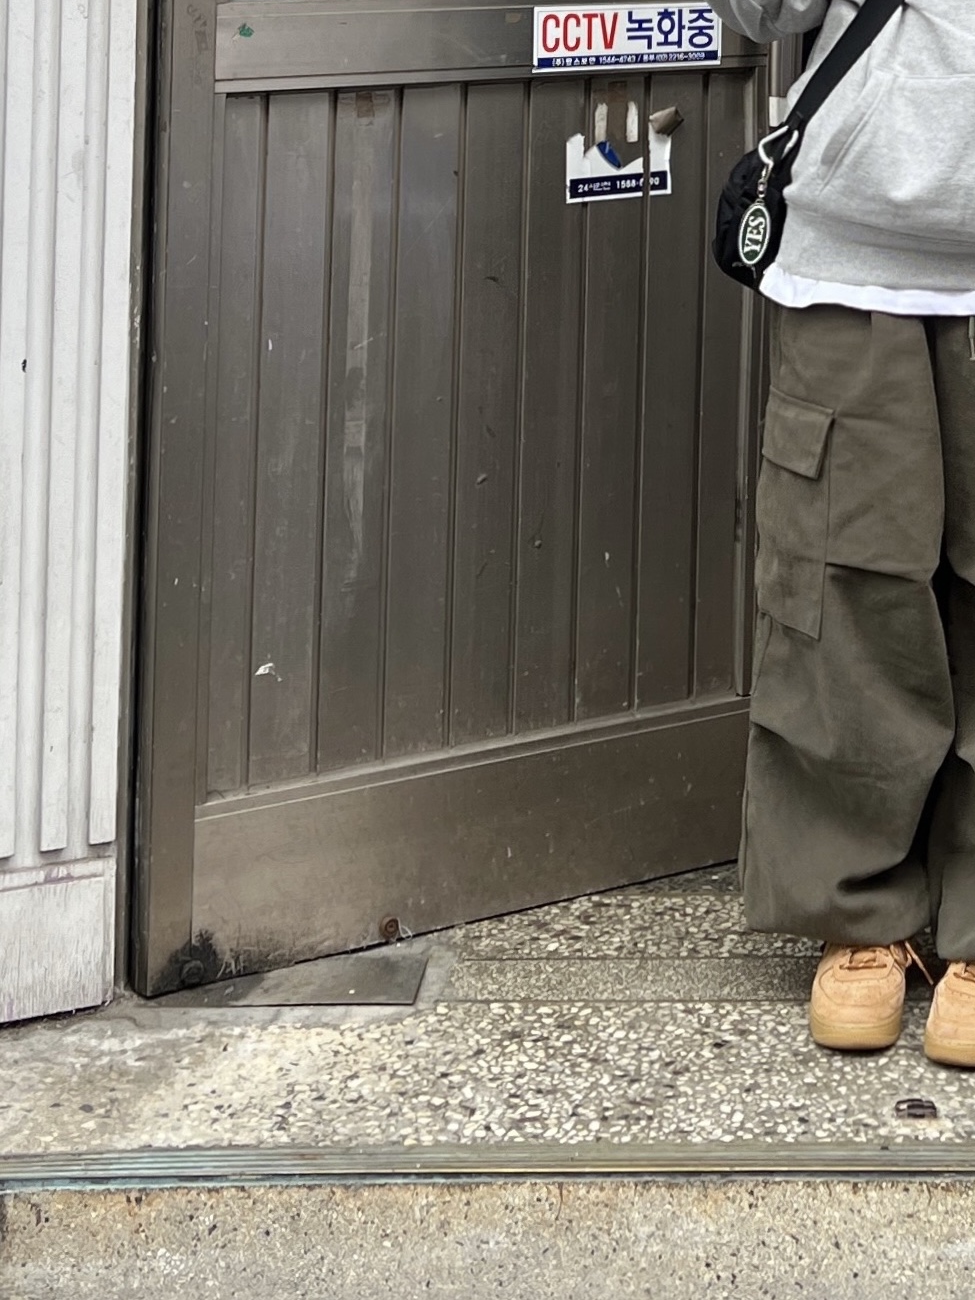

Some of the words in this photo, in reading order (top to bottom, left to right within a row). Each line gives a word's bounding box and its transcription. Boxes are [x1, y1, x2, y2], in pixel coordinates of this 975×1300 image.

[542, 12, 619, 52] CCTV
[625, 8, 715, 50] 녹화중
[743, 215, 766, 253] YES
